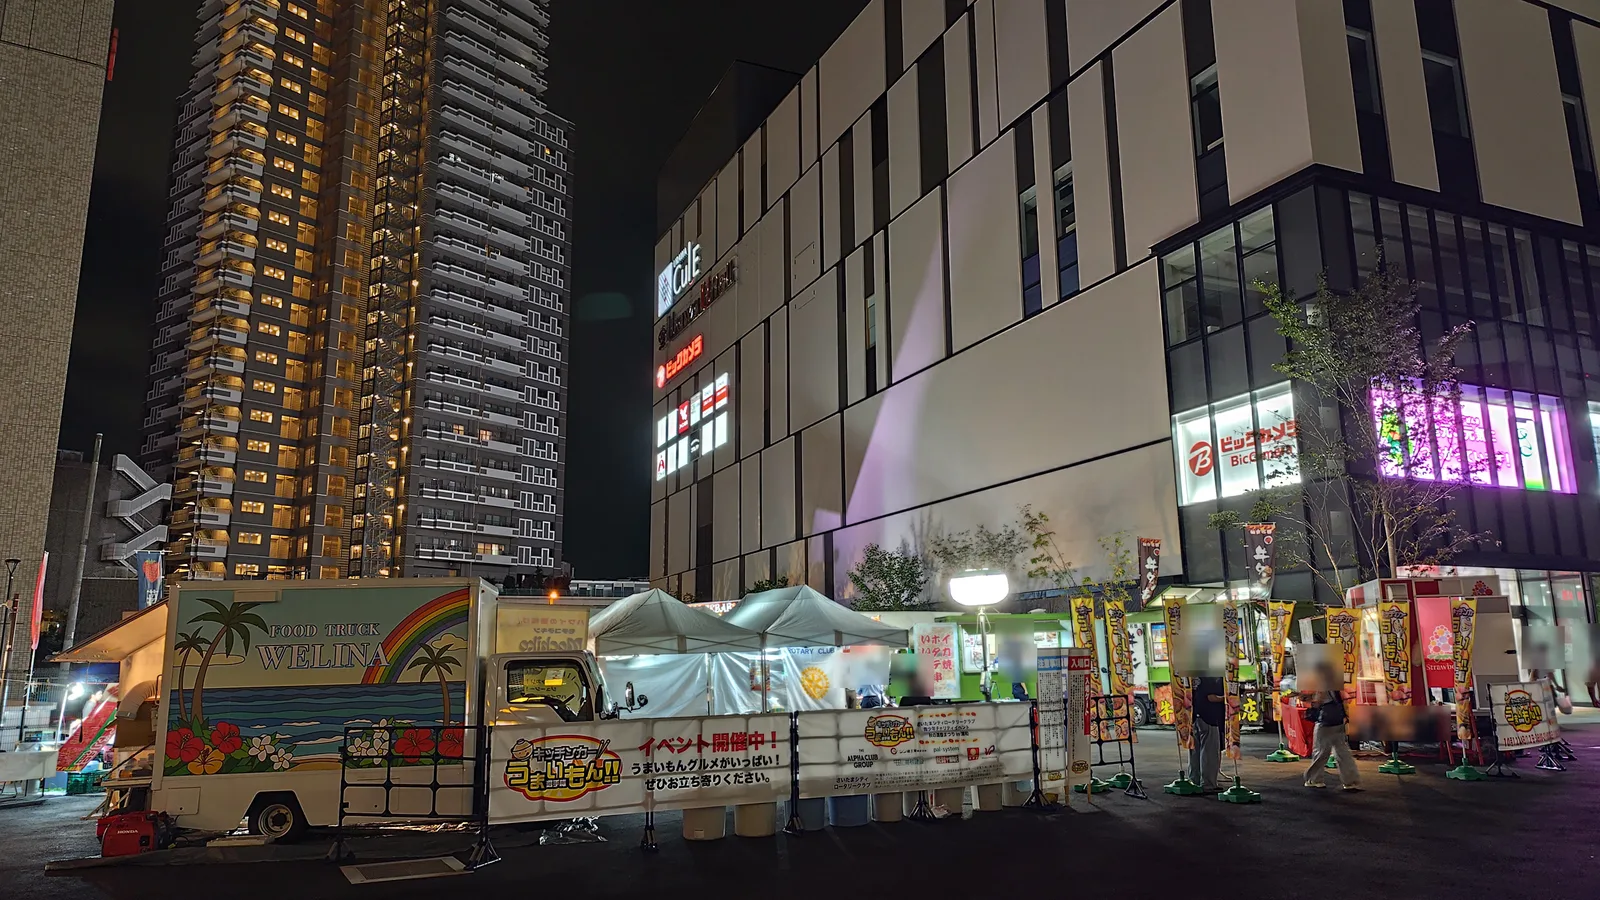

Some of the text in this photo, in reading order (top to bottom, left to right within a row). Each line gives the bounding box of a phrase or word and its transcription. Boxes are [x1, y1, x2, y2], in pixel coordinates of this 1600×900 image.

[665, 335, 703, 379] ビックカメラ
[270, 623, 380, 638] FOOD TRUCK
[255, 642, 391, 670] WELINA
[818, 647, 835, 655] CLUB
[533, 745, 598, 761] キッチンカー
[638, 731, 777, 757] イベント開催中！
[631, 754, 780, 775] うまいもんグルメがいっぱい！
[506, 759, 622, 791] うまいもん!!
[645, 772, 770, 791] ぜひお立ち寄りください。
[836, 776, 869, 784] さいたまシティ
[834, 782, 872, 790] ロータリークラブ
